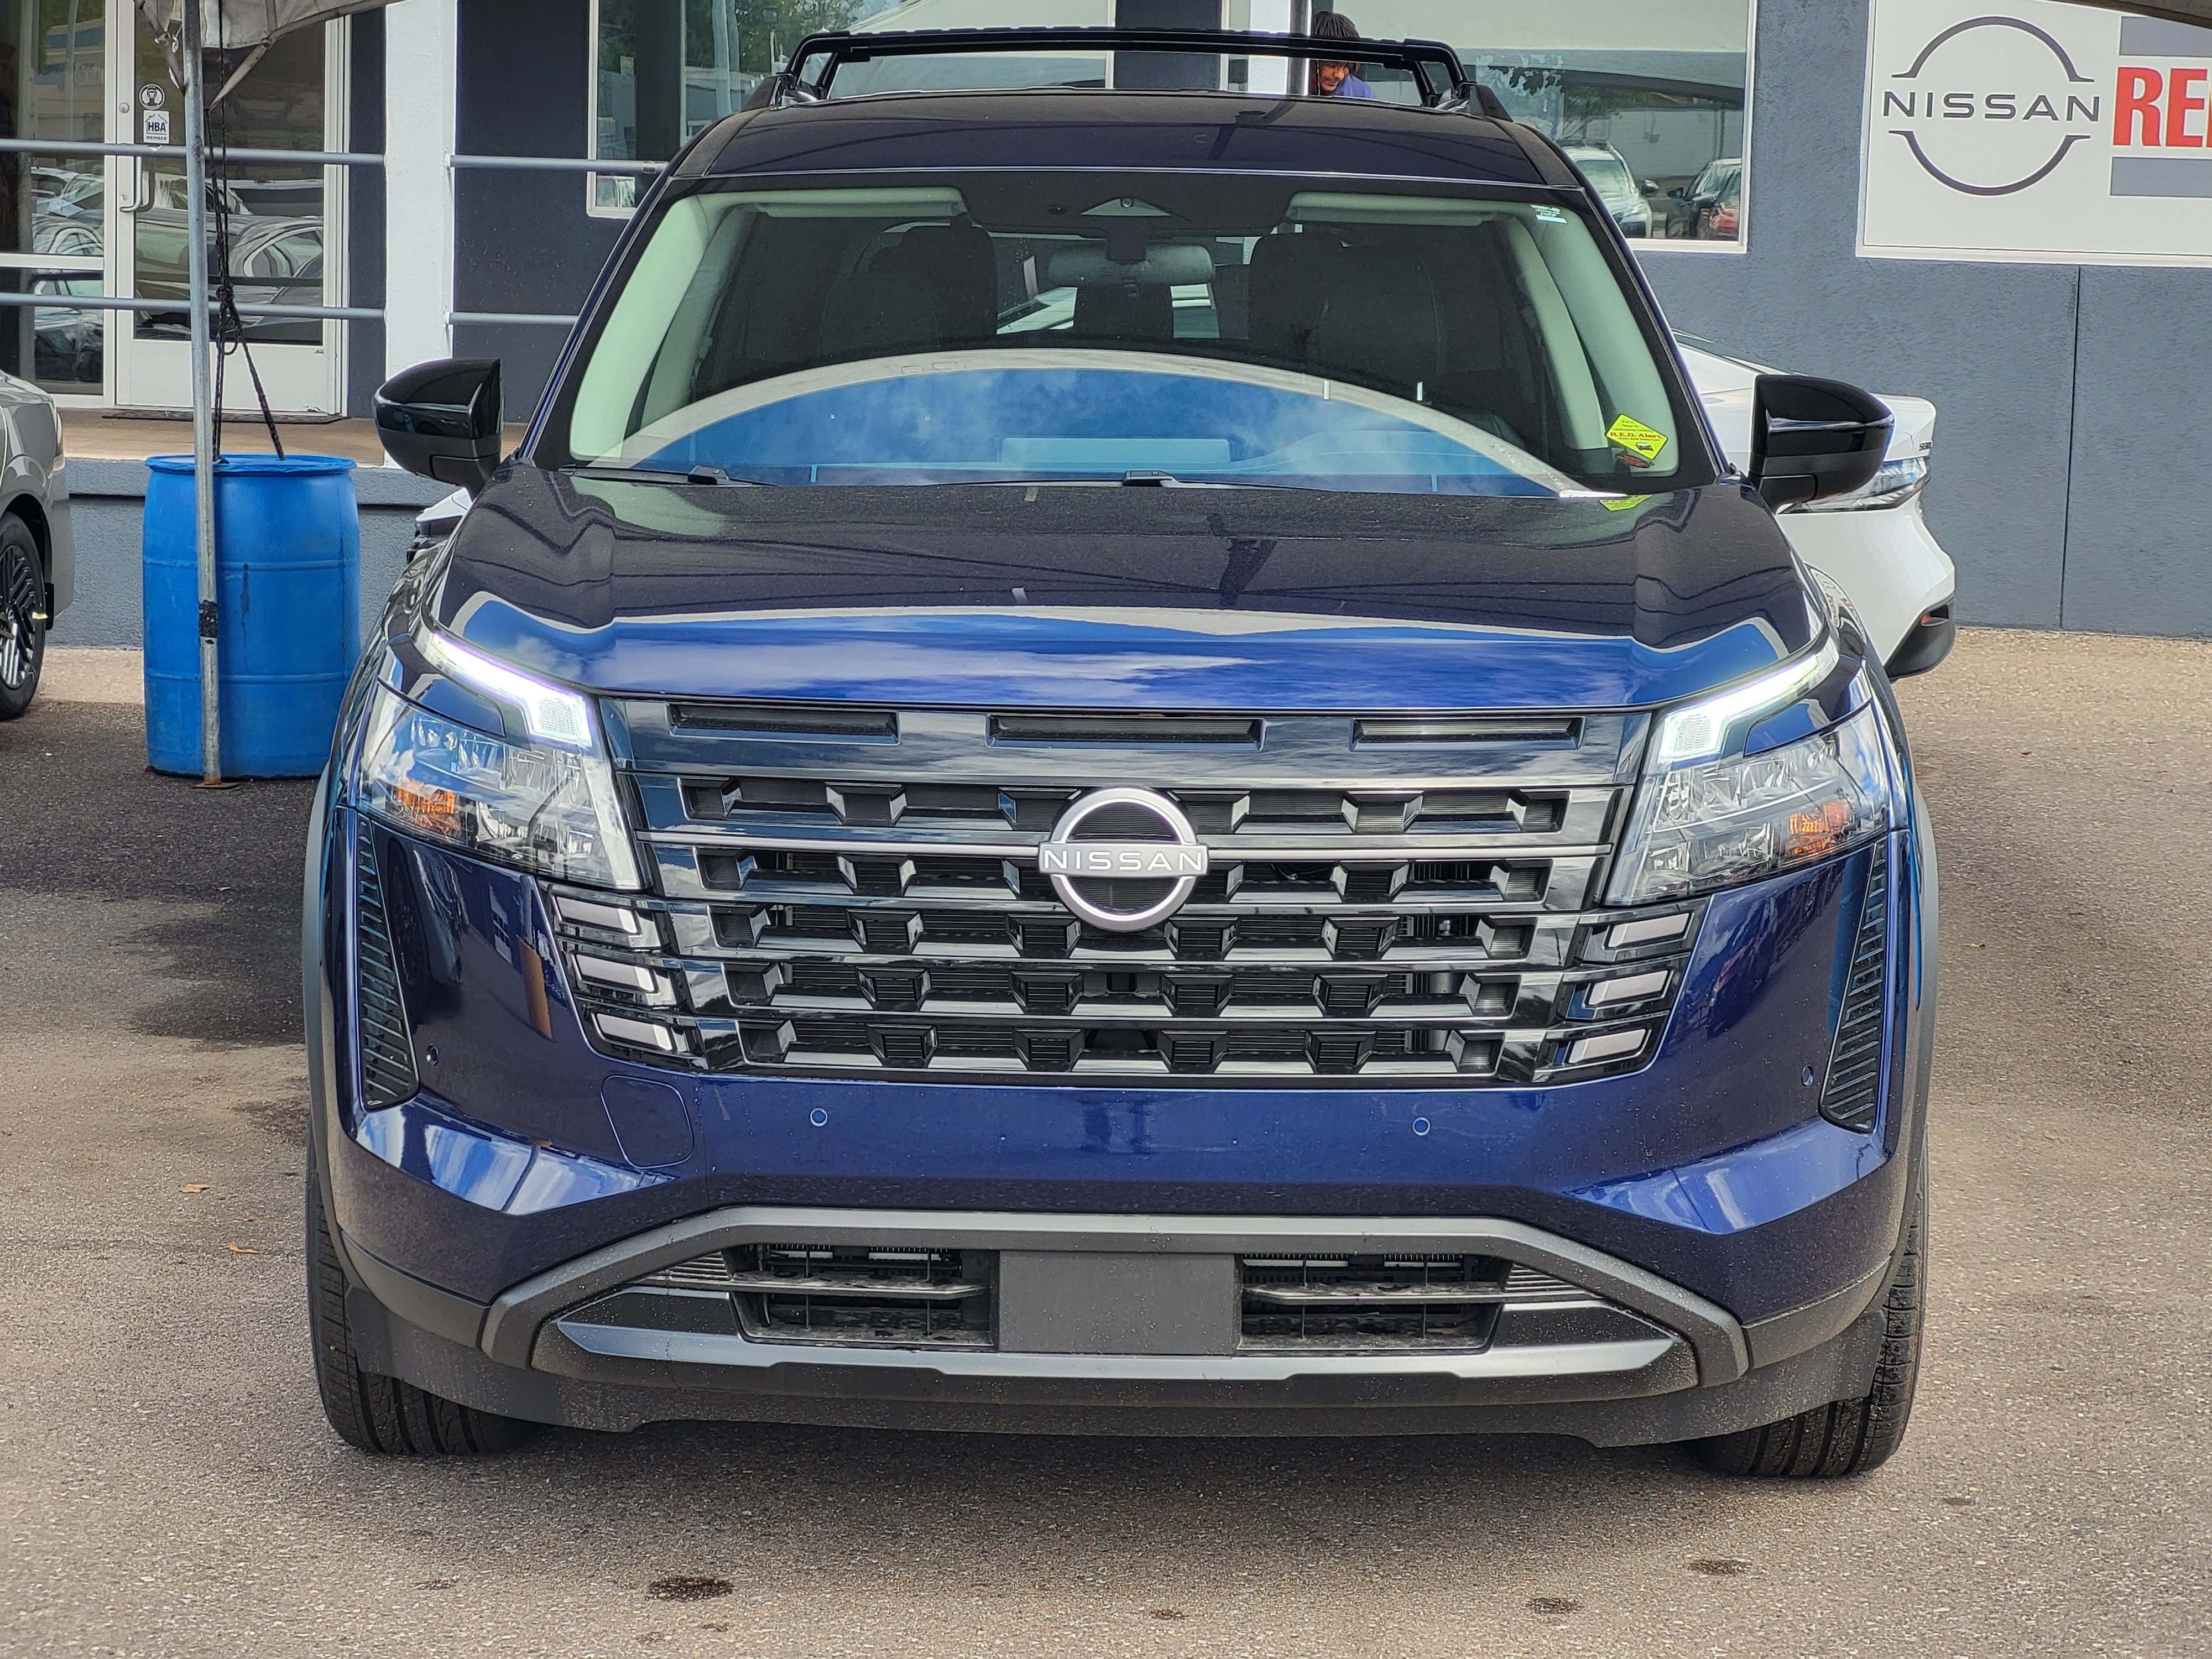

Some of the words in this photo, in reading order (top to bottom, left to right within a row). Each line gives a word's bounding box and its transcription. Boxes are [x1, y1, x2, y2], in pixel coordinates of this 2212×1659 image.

[1882, 91, 2100, 122] NISSAN
[2112, 66, 2212, 148] RE
[148, 121, 166, 132] HBA
[1044, 849, 1202, 871] NISSAN
